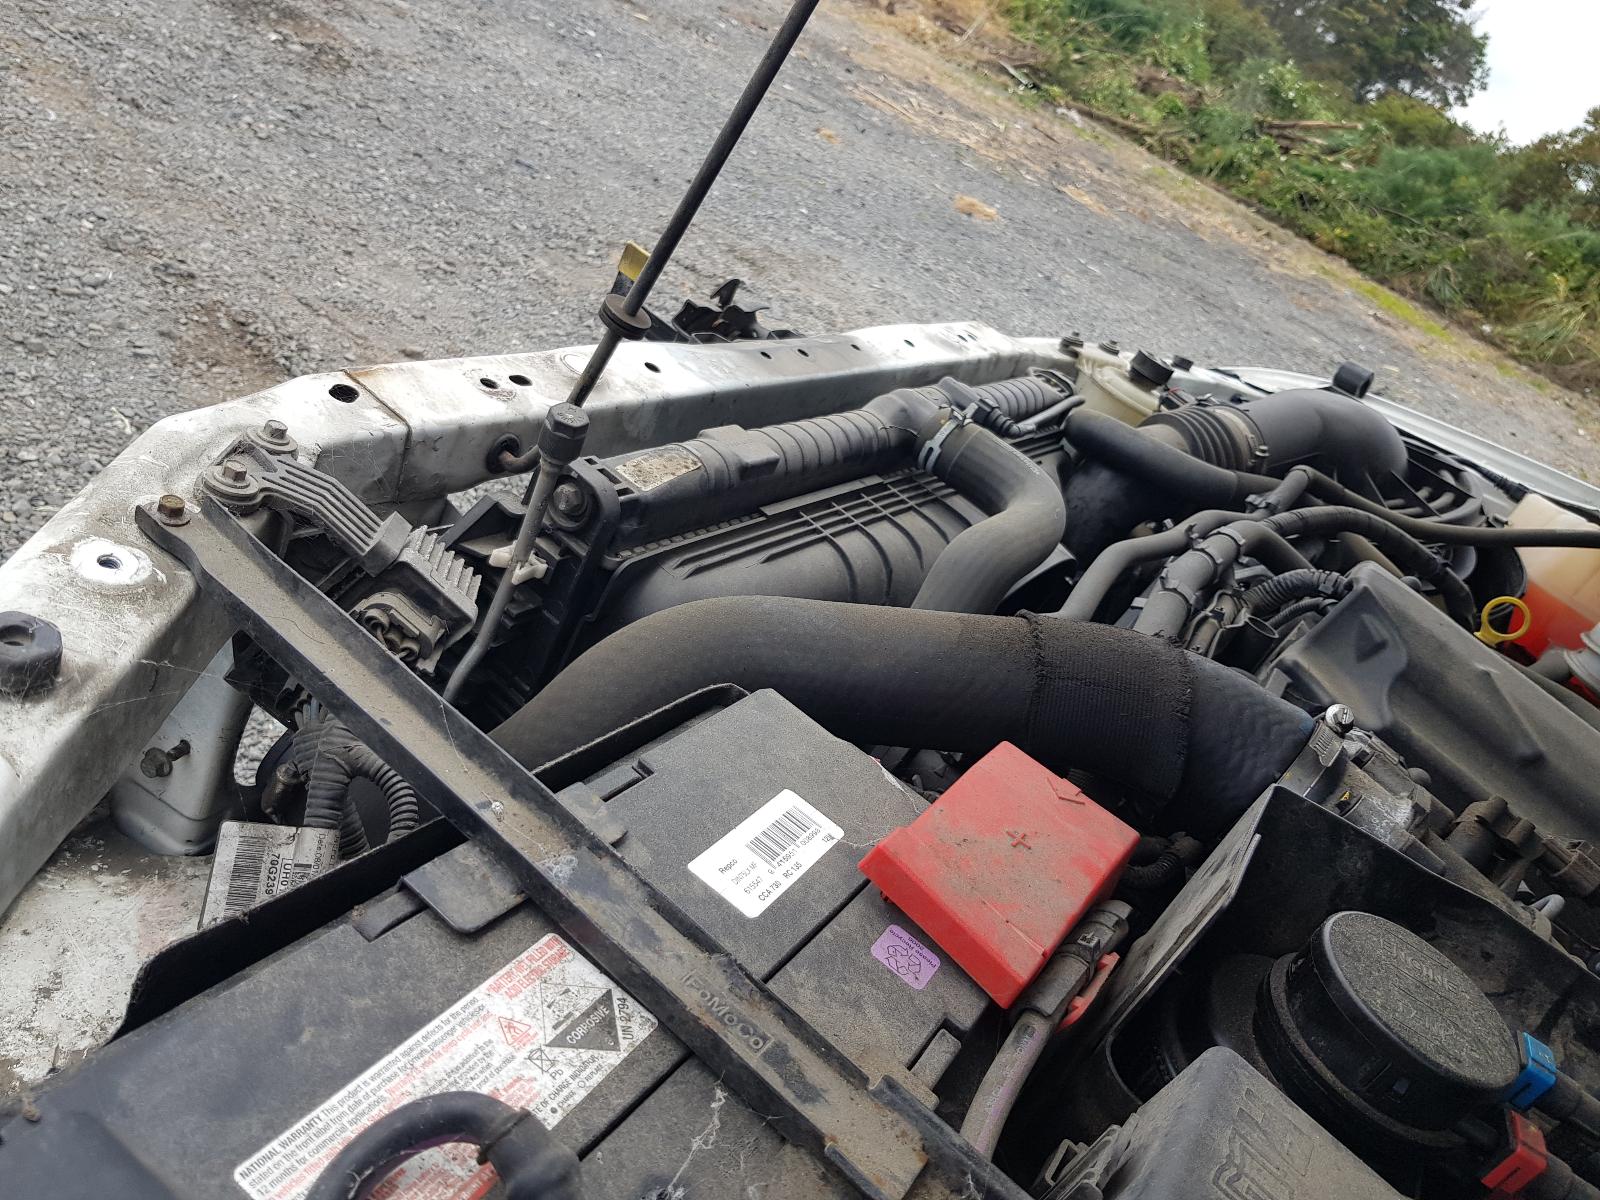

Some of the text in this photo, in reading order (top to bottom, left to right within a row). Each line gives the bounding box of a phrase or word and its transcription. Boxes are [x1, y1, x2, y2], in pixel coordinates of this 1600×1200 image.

[265, 853, 281, 895] 70G239
[280, 862, 292, 887] UH0
[718, 859, 737, 874] Repco
[758, 889, 772, 901] CCA
[782, 869, 793, 879] RC
[889, 929, 937, 968] Please Recycle
[566, 1005, 610, 1044] CORROSIVE
[616, 997, 634, 1041] UN 2794
[685, 978, 765, 1051] FoMoCo
[240, 1148, 279, 1179] NATIONAL
[279, 1115, 321, 1148] WARRANTY
[321, 1104, 338, 1117] This
[337, 1084, 363, 1107] product
[369, 1056, 401, 1081] warranted
[400, 1040, 423, 1058] against
[421, 1024, 443, 1042] defects
[440, 1017, 451, 1026] for
[449, 1010, 462, 1020] the
[460, 997, 479, 1013] period
[540, 1098, 551, 1108] OF
[548, 1079, 571, 1100] CHARGE
[570, 1055, 598, 1080] INDICATOR
[549, 1069, 564, 1080] Pb
[249, 1167, 274, 1188] stated
[273, 1159, 284, 1170] on
[282, 1150, 297, 1162] the
[295, 1134, 315, 1151] front
[312, 1122, 332, 1138] label
[330, 1111, 349, 1125] from
[347, 1099, 363, 1113] date
[362, 1091, 372, 1101] of
[370, 1071, 399, 1096] purchase
[397, 1063, 409, 1073] for
[408, 1048, 430, 1067] private
[428, 1026, 457, 1051] passenger
[256, 1185, 270, 1196] 12
[269, 1164, 298, 1188] months
[295, 1155, 308, 1166] for
[308, 1123, 348, 1157] commercial
